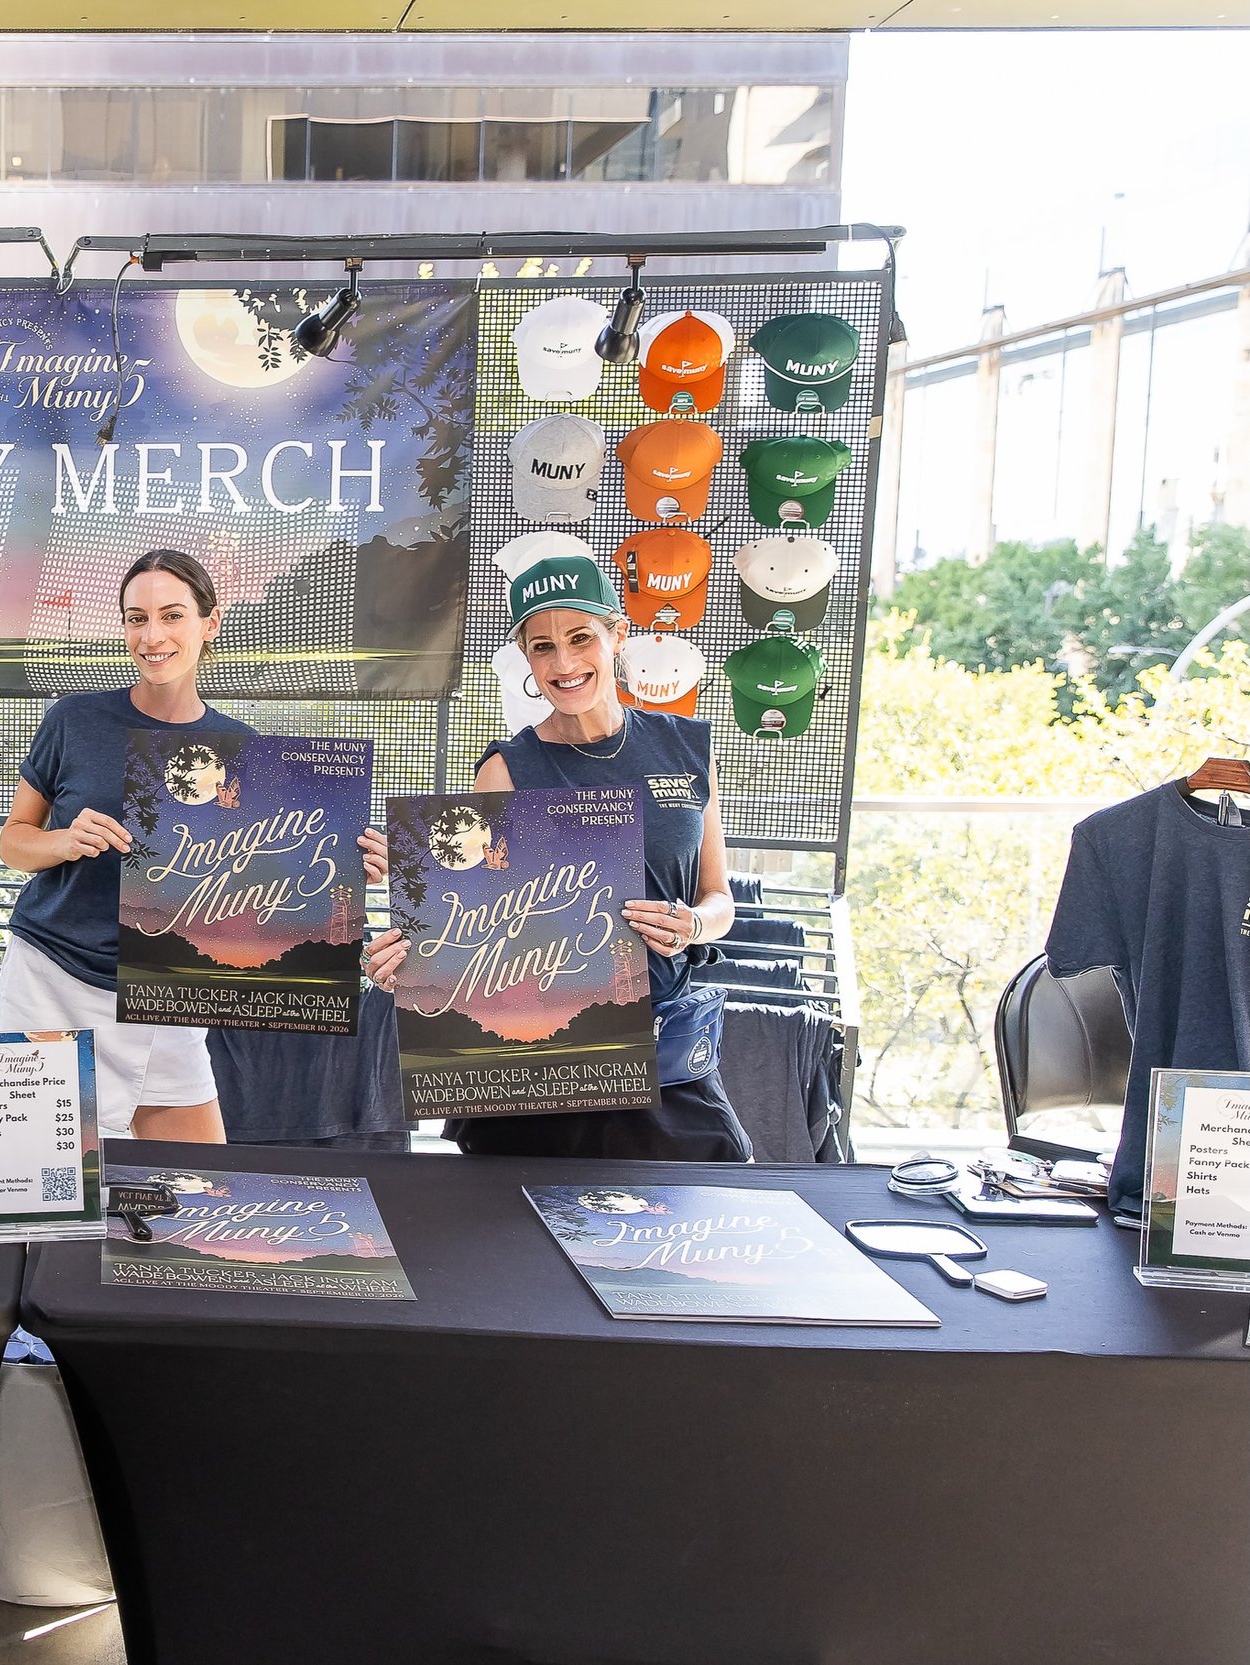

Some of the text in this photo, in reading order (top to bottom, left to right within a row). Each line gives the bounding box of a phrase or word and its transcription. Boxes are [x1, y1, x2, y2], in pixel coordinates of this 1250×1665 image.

[17, 318, 53, 350] PRESENTS
[785, 359, 839, 376] MUNY
[13, 376, 112, 422] Muny
[51, 439, 386, 514] MERCH
[531, 458, 586, 480] MUNY
[522, 574, 579, 603] MUNY
[647, 572, 692, 592] MUNY
[637, 680, 680, 698] MUNY
[311, 741, 366, 752] THE MUNY
[282, 752, 365, 765] CONSERVANCY
[314, 765, 365, 777] PRESENTS
[648, 778, 689, 788] save
[576, 789, 634, 800] THE MUNY
[652, 788, 695, 799] muny.
[547, 802, 634, 814] CONSERVANCY
[582, 814, 635, 825] PRESENTS
[147, 807, 326, 882] Imagine
[136, 834, 338, 936] Muny 5
[419, 860, 599, 957] Imagine
[413, 886, 613, 1018] Muny 5
[127, 984, 349, 1009] TANYA TUCKER JACK INGRAM
[125, 998, 350, 1023] WADE BOWEN and ASLEEP WHEEL
[142, 1014, 160, 1022] LIVE
[191, 1017, 222, 1026] MOODY
[223, 1018, 260, 1027] THEATER
[268, 1022, 316, 1031] SEPTEMBER
[330, 1025, 349, 1033] 2026
[42, 1078, 66, 1086] Price
[412, 1062, 647, 1087] TANYA TUCKER JACK INGRAM
[10, 1091, 36, 1099] Sheet
[412, 1078, 651, 1103] WADE BOWEN and ASLEEP WHEEL
[56, 1099, 71, 1108] $15
[414, 1108, 431, 1116] ACL
[432, 1107, 451, 1115] LIVE
[453, 1106, 464, 1114] AT
[466, 1105, 483, 1113] THE
[484, 1103, 517, 1112] MOODY
[518, 1101, 558, 1111] THEATER
[566, 1097, 618, 1108] SEPTEMBER
[632, 1096, 652, 1104] 2026
[6, 1114, 28, 1122] Pack
[55, 1113, 74, 1122] $25
[56, 1127, 74, 1136] $30
[56, 1142, 75, 1150] $30
[1190, 1145, 1228, 1155] Posters
[1189, 1157, 1250, 1169] Fanny Pack
[1186, 1172, 1217, 1181] Shirts
[1186, 1186, 1210, 1195] Hats
[122, 1211, 350, 1245] Muny 5
[592, 1214, 777, 1246] Imagine
[600, 1227, 814, 1271] Muny 5
[114, 1263, 256, 1278] TANYA TUCKER
